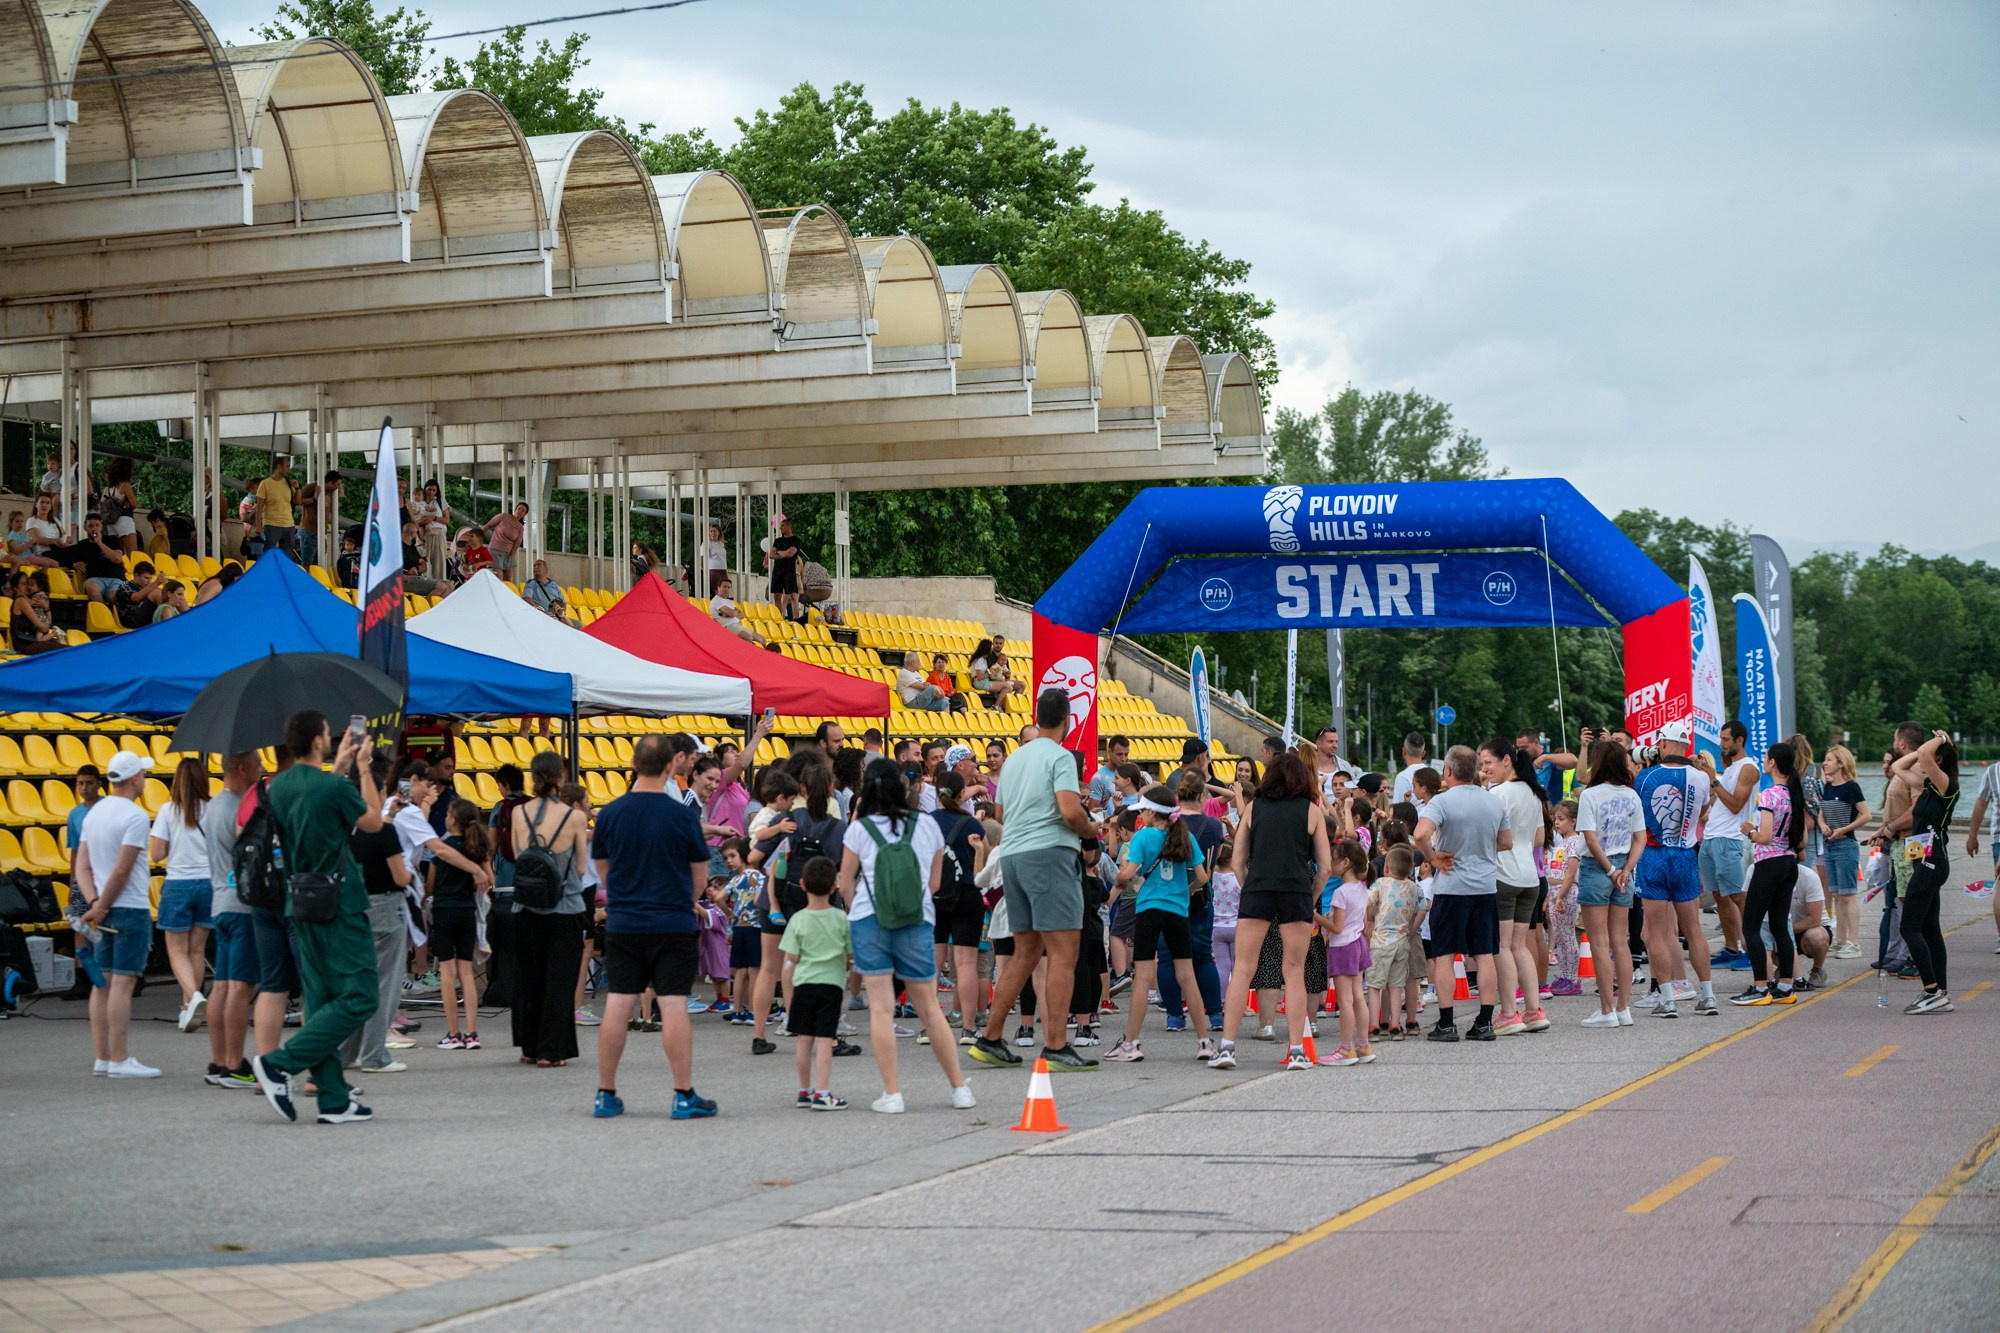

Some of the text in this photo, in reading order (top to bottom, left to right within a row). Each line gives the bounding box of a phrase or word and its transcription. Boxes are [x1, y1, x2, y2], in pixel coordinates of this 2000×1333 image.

[1309, 494, 1398, 516] PLOVDIV
[1309, 520, 1367, 541] HILLS
[1205, 588, 1227, 599] P/H
[1275, 563, 1440, 618] START
[1488, 582, 1510, 593] P/H
[1625, 678, 1670, 717] VERY
[1638, 693, 1687, 734] STEP
[1682, 819, 1690, 838] STEP
[1686, 784, 1695, 819] MATTERS
